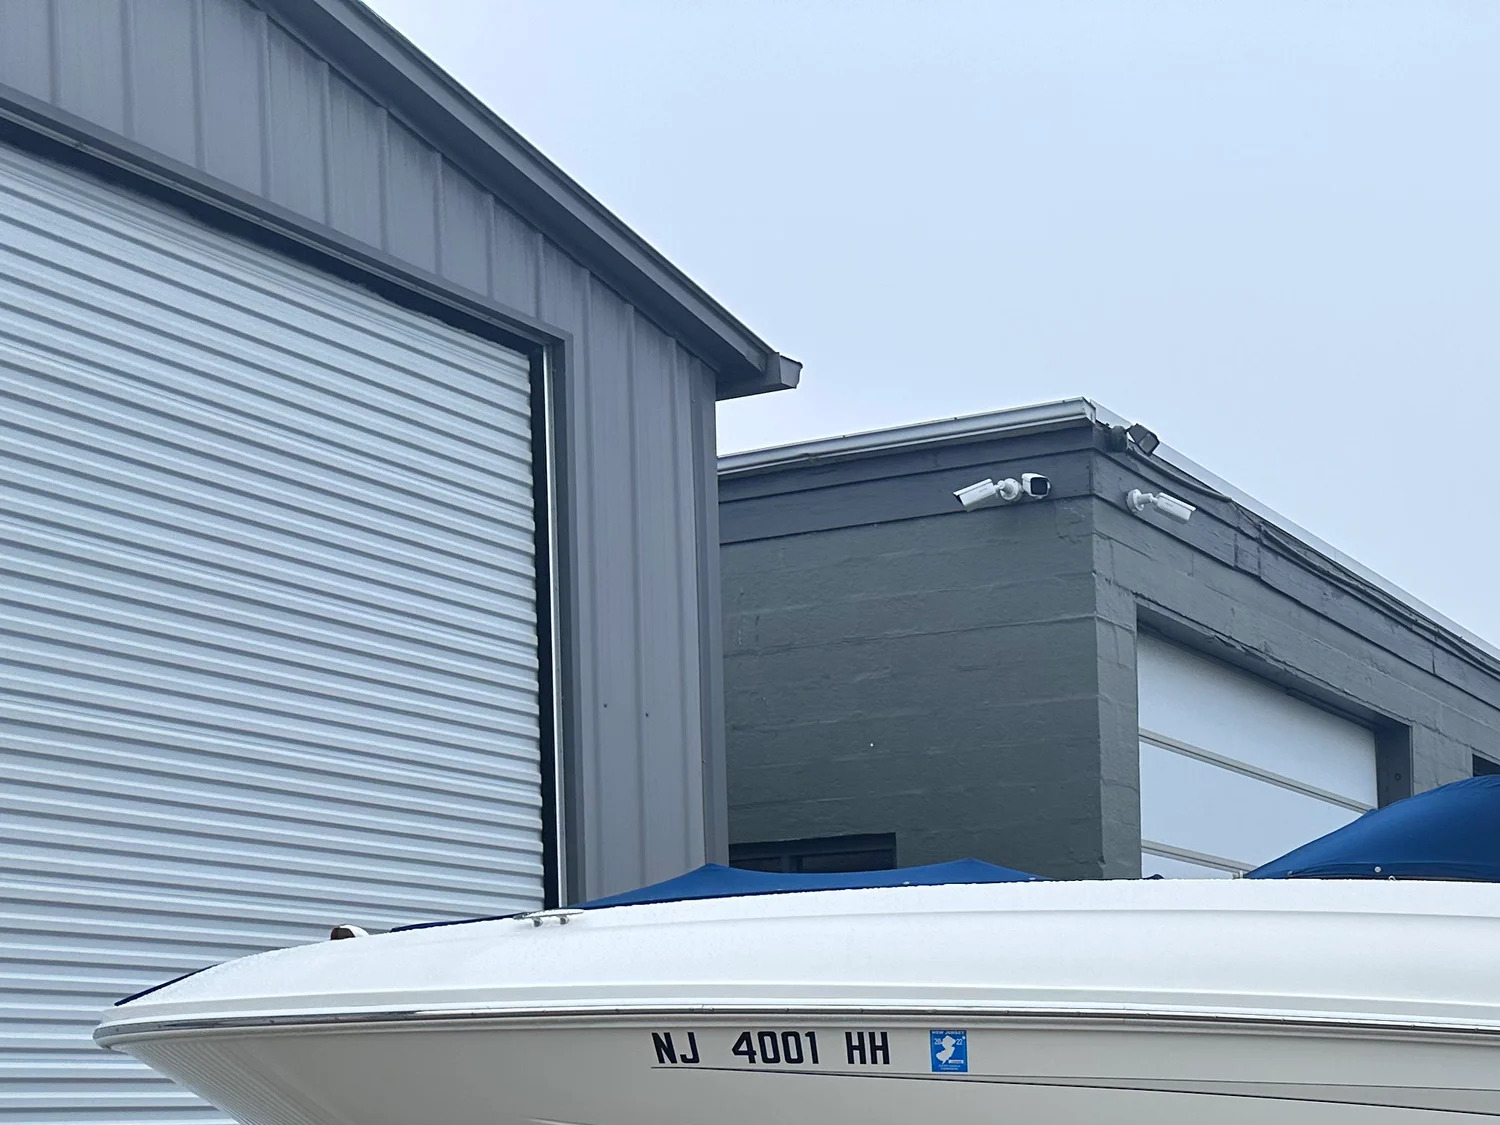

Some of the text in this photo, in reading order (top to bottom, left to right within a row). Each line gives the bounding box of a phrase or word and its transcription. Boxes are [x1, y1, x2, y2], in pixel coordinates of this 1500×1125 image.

[651, 1030, 890, 1065] NJ 4001 HH
